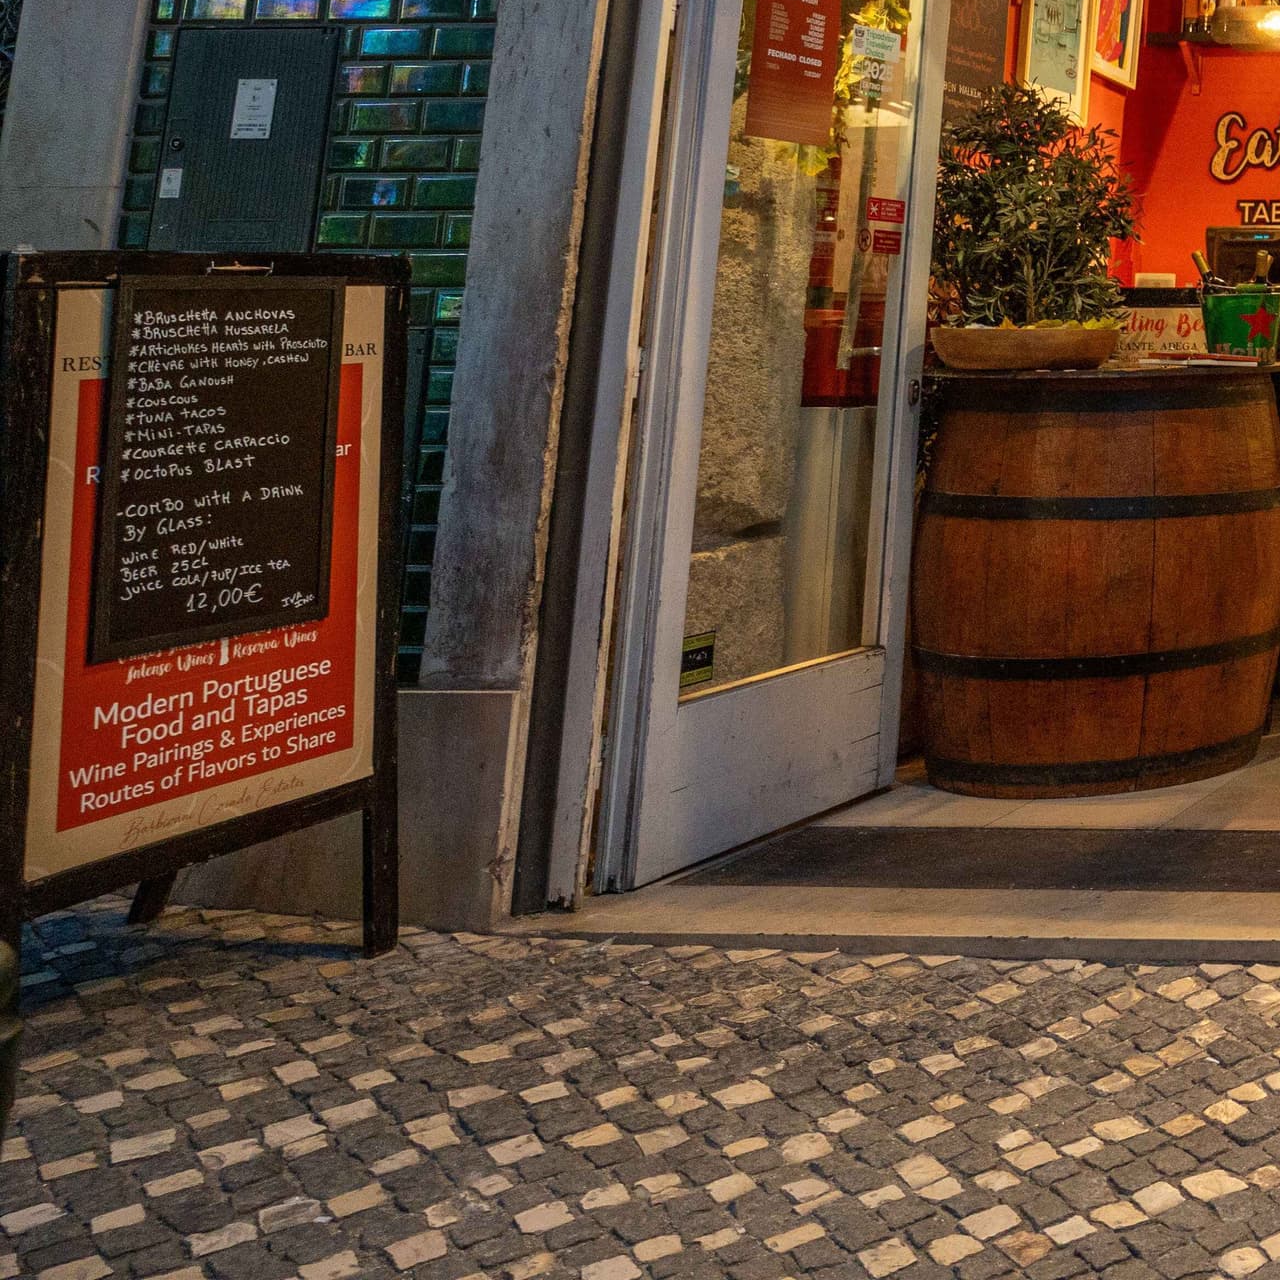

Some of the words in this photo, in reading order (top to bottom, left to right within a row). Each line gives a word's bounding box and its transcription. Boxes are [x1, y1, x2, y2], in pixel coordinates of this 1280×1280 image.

[344, 340, 378, 357] BAR
[137, 379, 173, 393] BABA
[179, 375, 234, 389] GANOUSH
[241, 490, 253, 503] A
[120, 565, 158, 583] BEER
[233, 639, 280, 659] Reserva
[93, 689, 194, 730] Modern
[202, 658, 333, 704] Portuguese
[120, 717, 184, 749] Food
[190, 699, 236, 731] and
[243, 687, 309, 717] Tapas
[68, 760, 127, 789] Wine
[132, 738, 215, 773] Pairings
[219, 730, 236, 749] &
[241, 702, 347, 743] Experiences
[78, 779, 155, 814] Routes
[160, 766, 183, 790] of
[187, 749, 257, 783] Flavors
[262, 742, 281, 761] to
[286, 729, 337, 756] Share
